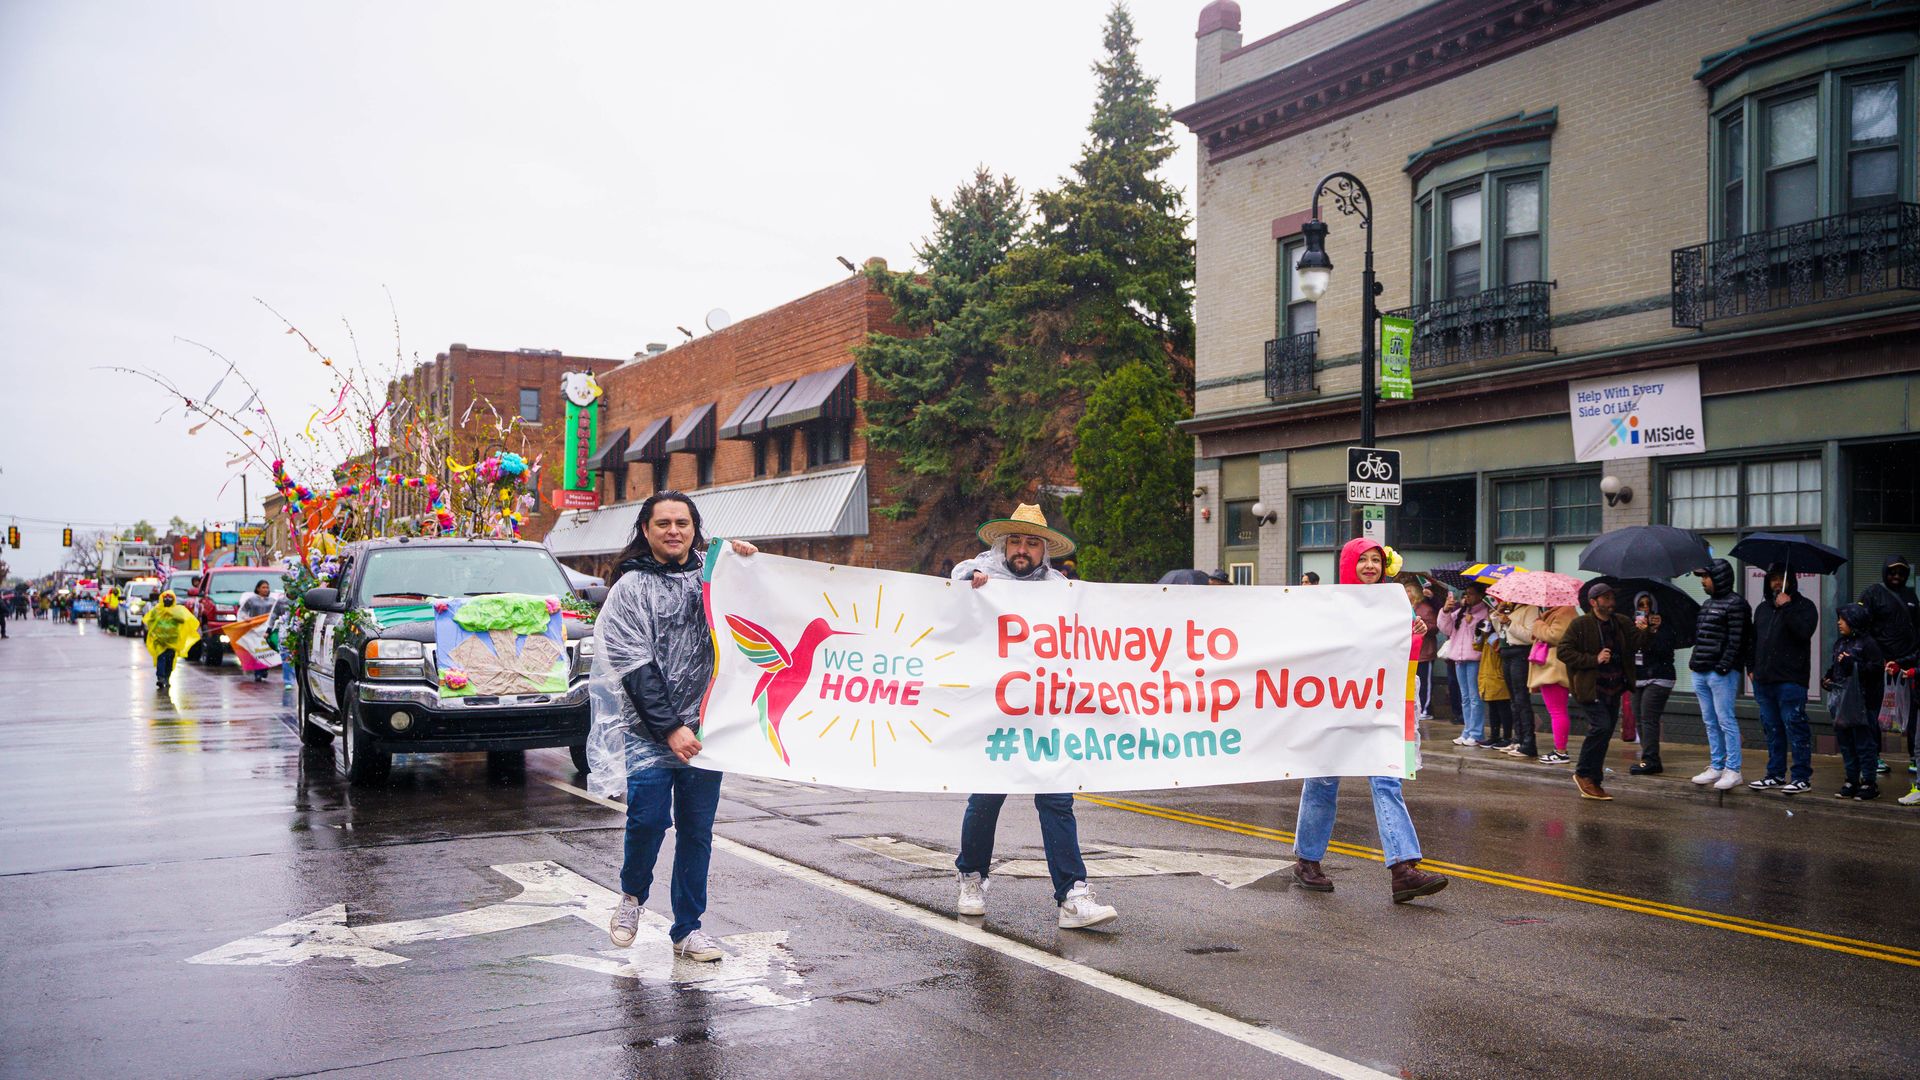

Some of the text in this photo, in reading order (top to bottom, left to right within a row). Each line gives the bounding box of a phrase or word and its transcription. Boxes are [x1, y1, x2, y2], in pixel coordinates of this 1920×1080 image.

[1384, 325, 1410, 333] Welcome
[1577, 384, 1664, 403] Help With Every
[1579, 401, 1639, 417] Side Of Life.
[1644, 425, 1695, 443] MiSide
[1350, 486, 1399, 500] BIKE LANE
[1504, 551, 1525, 561] 4220
[997, 613, 1239, 672] Pathway to
[824, 648, 924, 677] we are
[819, 673, 924, 706] HOME
[995, 667, 1386, 723] Citizenship Now!
[985, 727, 1241, 762] #WeAreHome
